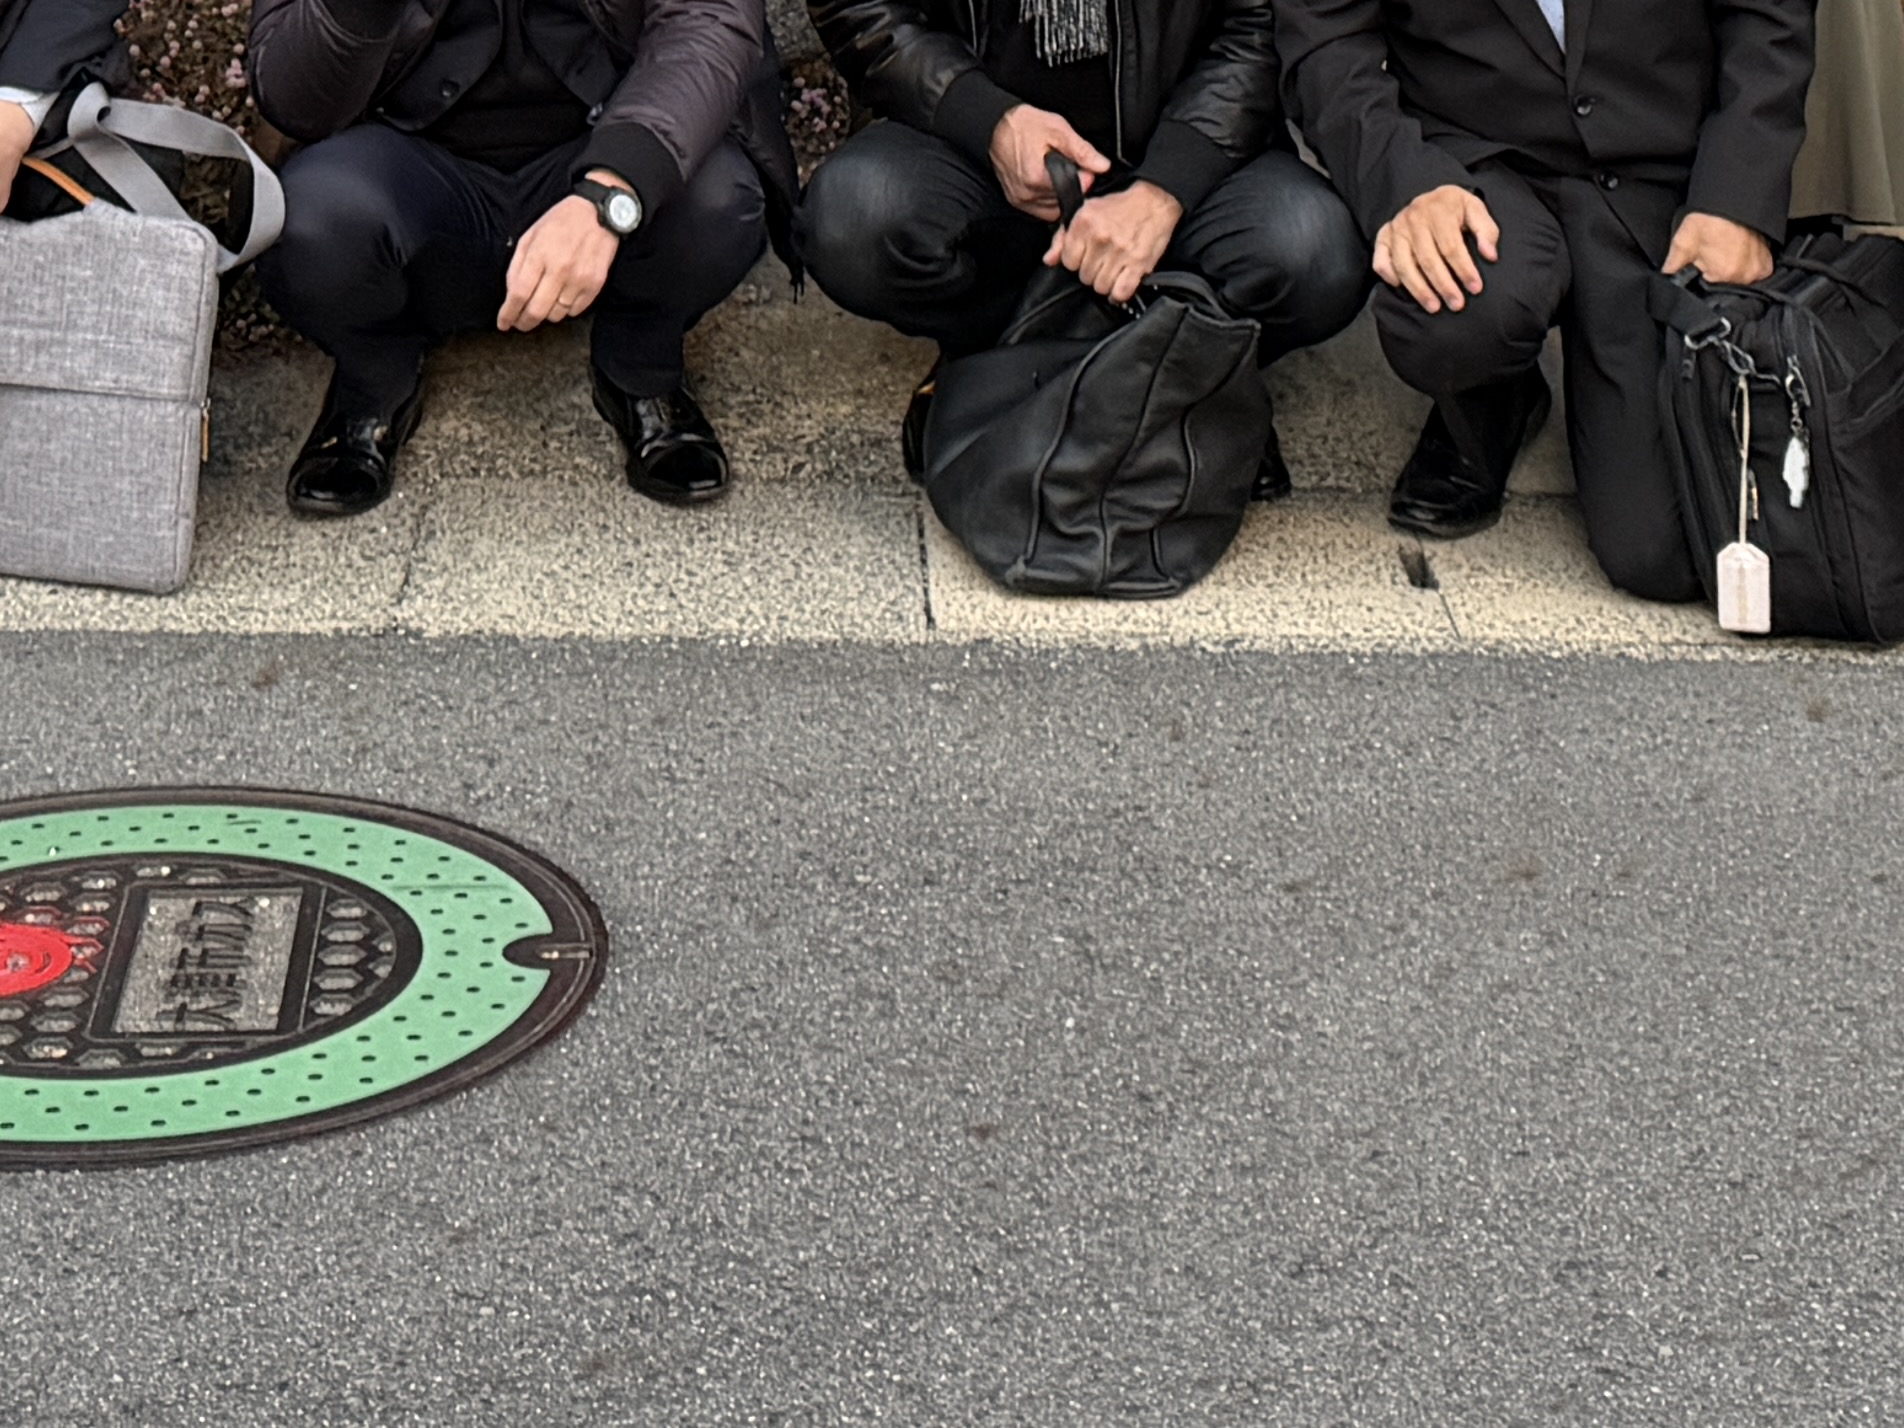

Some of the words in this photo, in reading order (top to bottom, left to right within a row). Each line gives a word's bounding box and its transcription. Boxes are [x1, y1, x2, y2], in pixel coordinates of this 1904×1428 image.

[154, 897, 254, 1031] 大津市ガス
